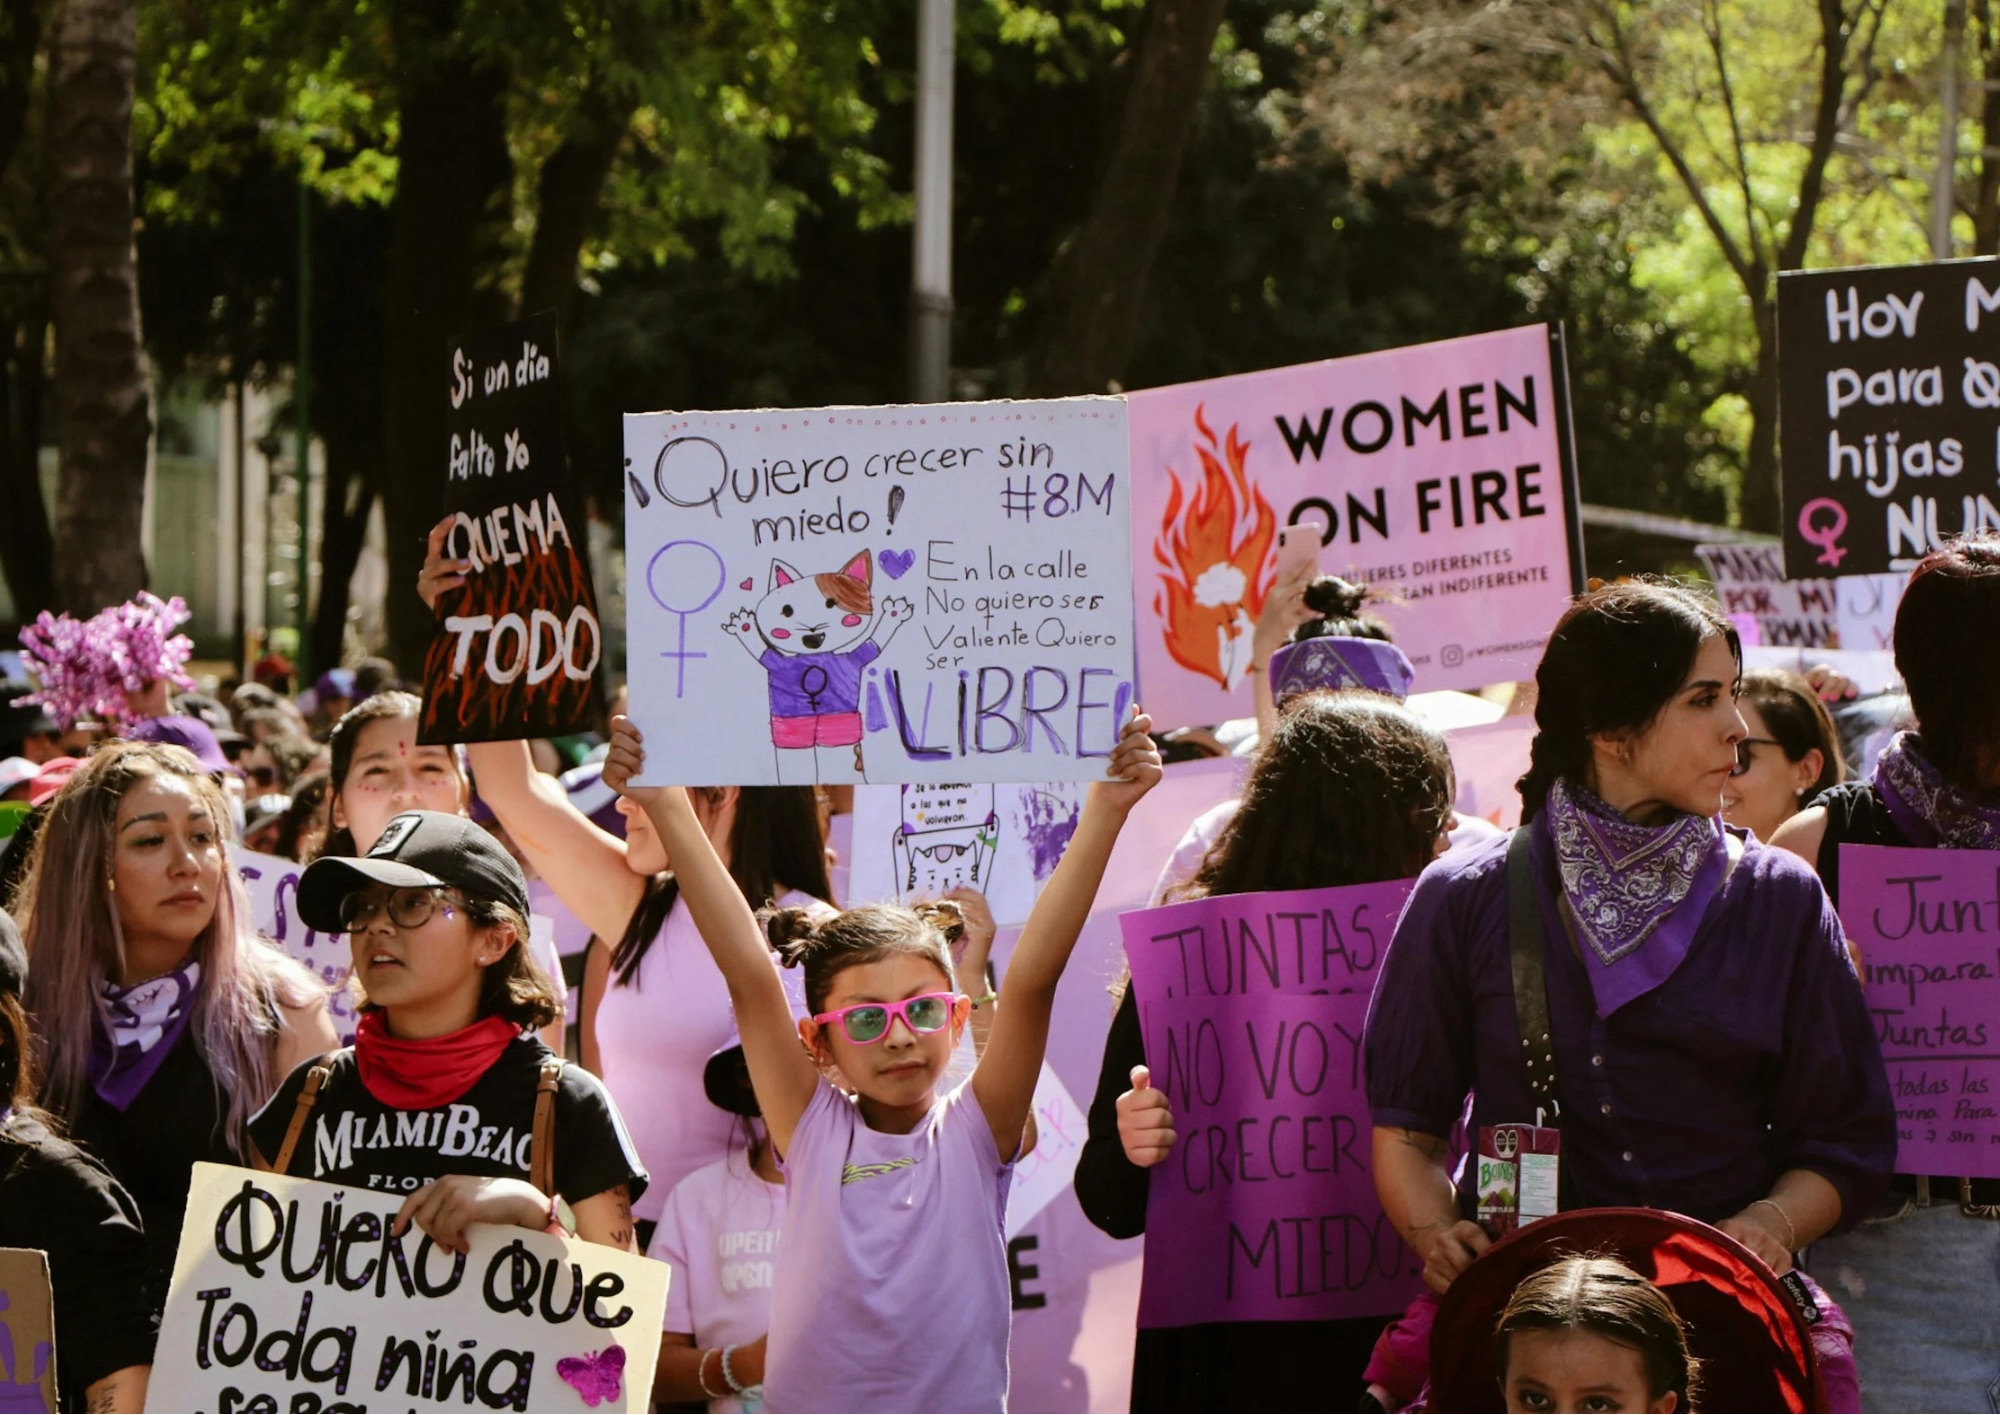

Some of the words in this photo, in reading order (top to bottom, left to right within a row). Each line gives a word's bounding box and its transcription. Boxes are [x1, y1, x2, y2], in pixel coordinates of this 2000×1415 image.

[450, 347, 473, 410] Si
[484, 360, 509, 396] un
[1826, 365, 1944, 420] para
[1274, 374, 1539, 464] WOMEN
[504, 427, 530, 472] Yo
[864, 447, 984, 478] crecer
[998, 436, 1054, 469] sin
[1828, 429, 1964, 498] hijas
[447, 492, 573, 575] QUEMA
[1287, 487, 1389, 548] ON
[1416, 463, 1547, 533] FIRE
[928, 540, 978, 581] En
[988, 545, 1015, 580] la
[1024, 549, 1088, 579] calle
[1412, 548, 1513, 576] DIFERENTES
[1439, 565, 1549, 595] INDIFERENTE
[923, 621, 1030, 650] Valiente
[1035, 617, 1117, 648] Quiero
[927, 586, 965, 615] No
[975, 591, 1054, 630] quiero
[444, 604, 601, 685] TODO
[926, 654, 965, 670] ser
[1151, 903, 1378, 998] JUNTAS
[1164, 1018, 1224, 1114] NO
[1246, 1020, 1363, 1100] VOY
[1961, 1066, 1990, 1096] las
[1182, 1115, 1367, 1194] CRECER
[196, 1289, 356, 1396] Toda
[375, 1328, 536, 1413] niña
